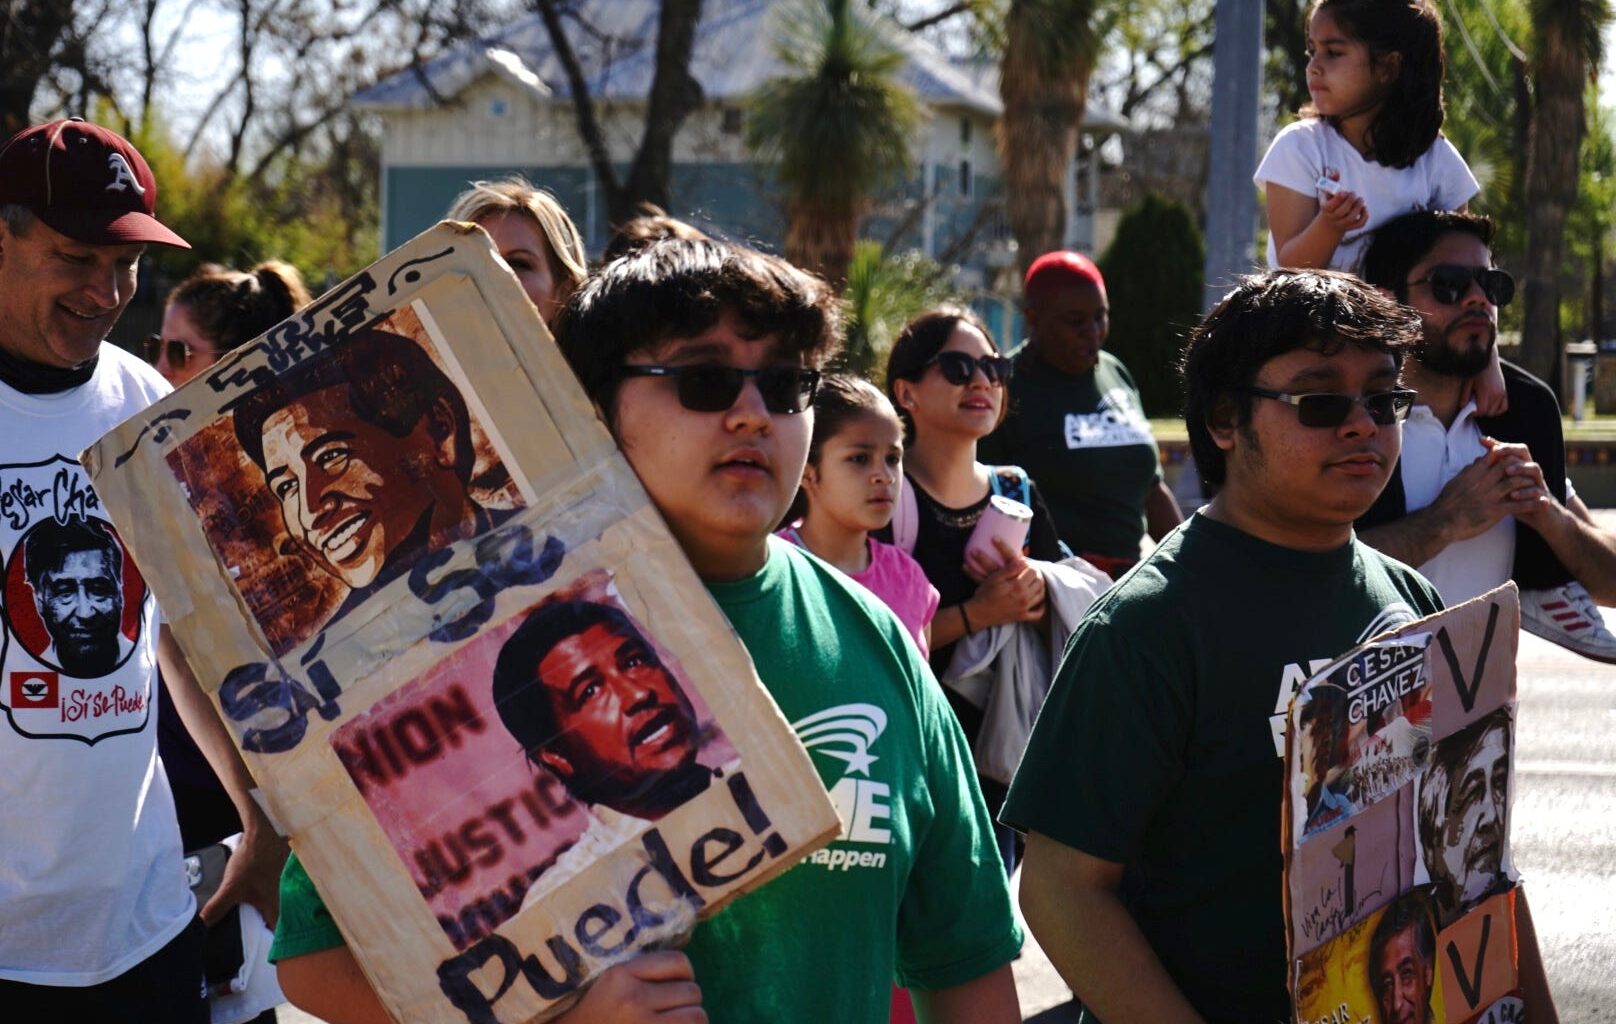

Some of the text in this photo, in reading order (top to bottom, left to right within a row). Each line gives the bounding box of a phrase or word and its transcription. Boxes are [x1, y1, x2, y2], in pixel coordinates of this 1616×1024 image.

[105, 152, 146, 196] A
[0, 467, 100, 531] esar Cha
[408, 524, 566, 643] Se
[332, 684, 487, 796] NION
[1348, 663, 1425, 724] CHAVEZ
[412, 770, 580, 899] JUSTIC
[436, 771, 789, 1024] Puede!
